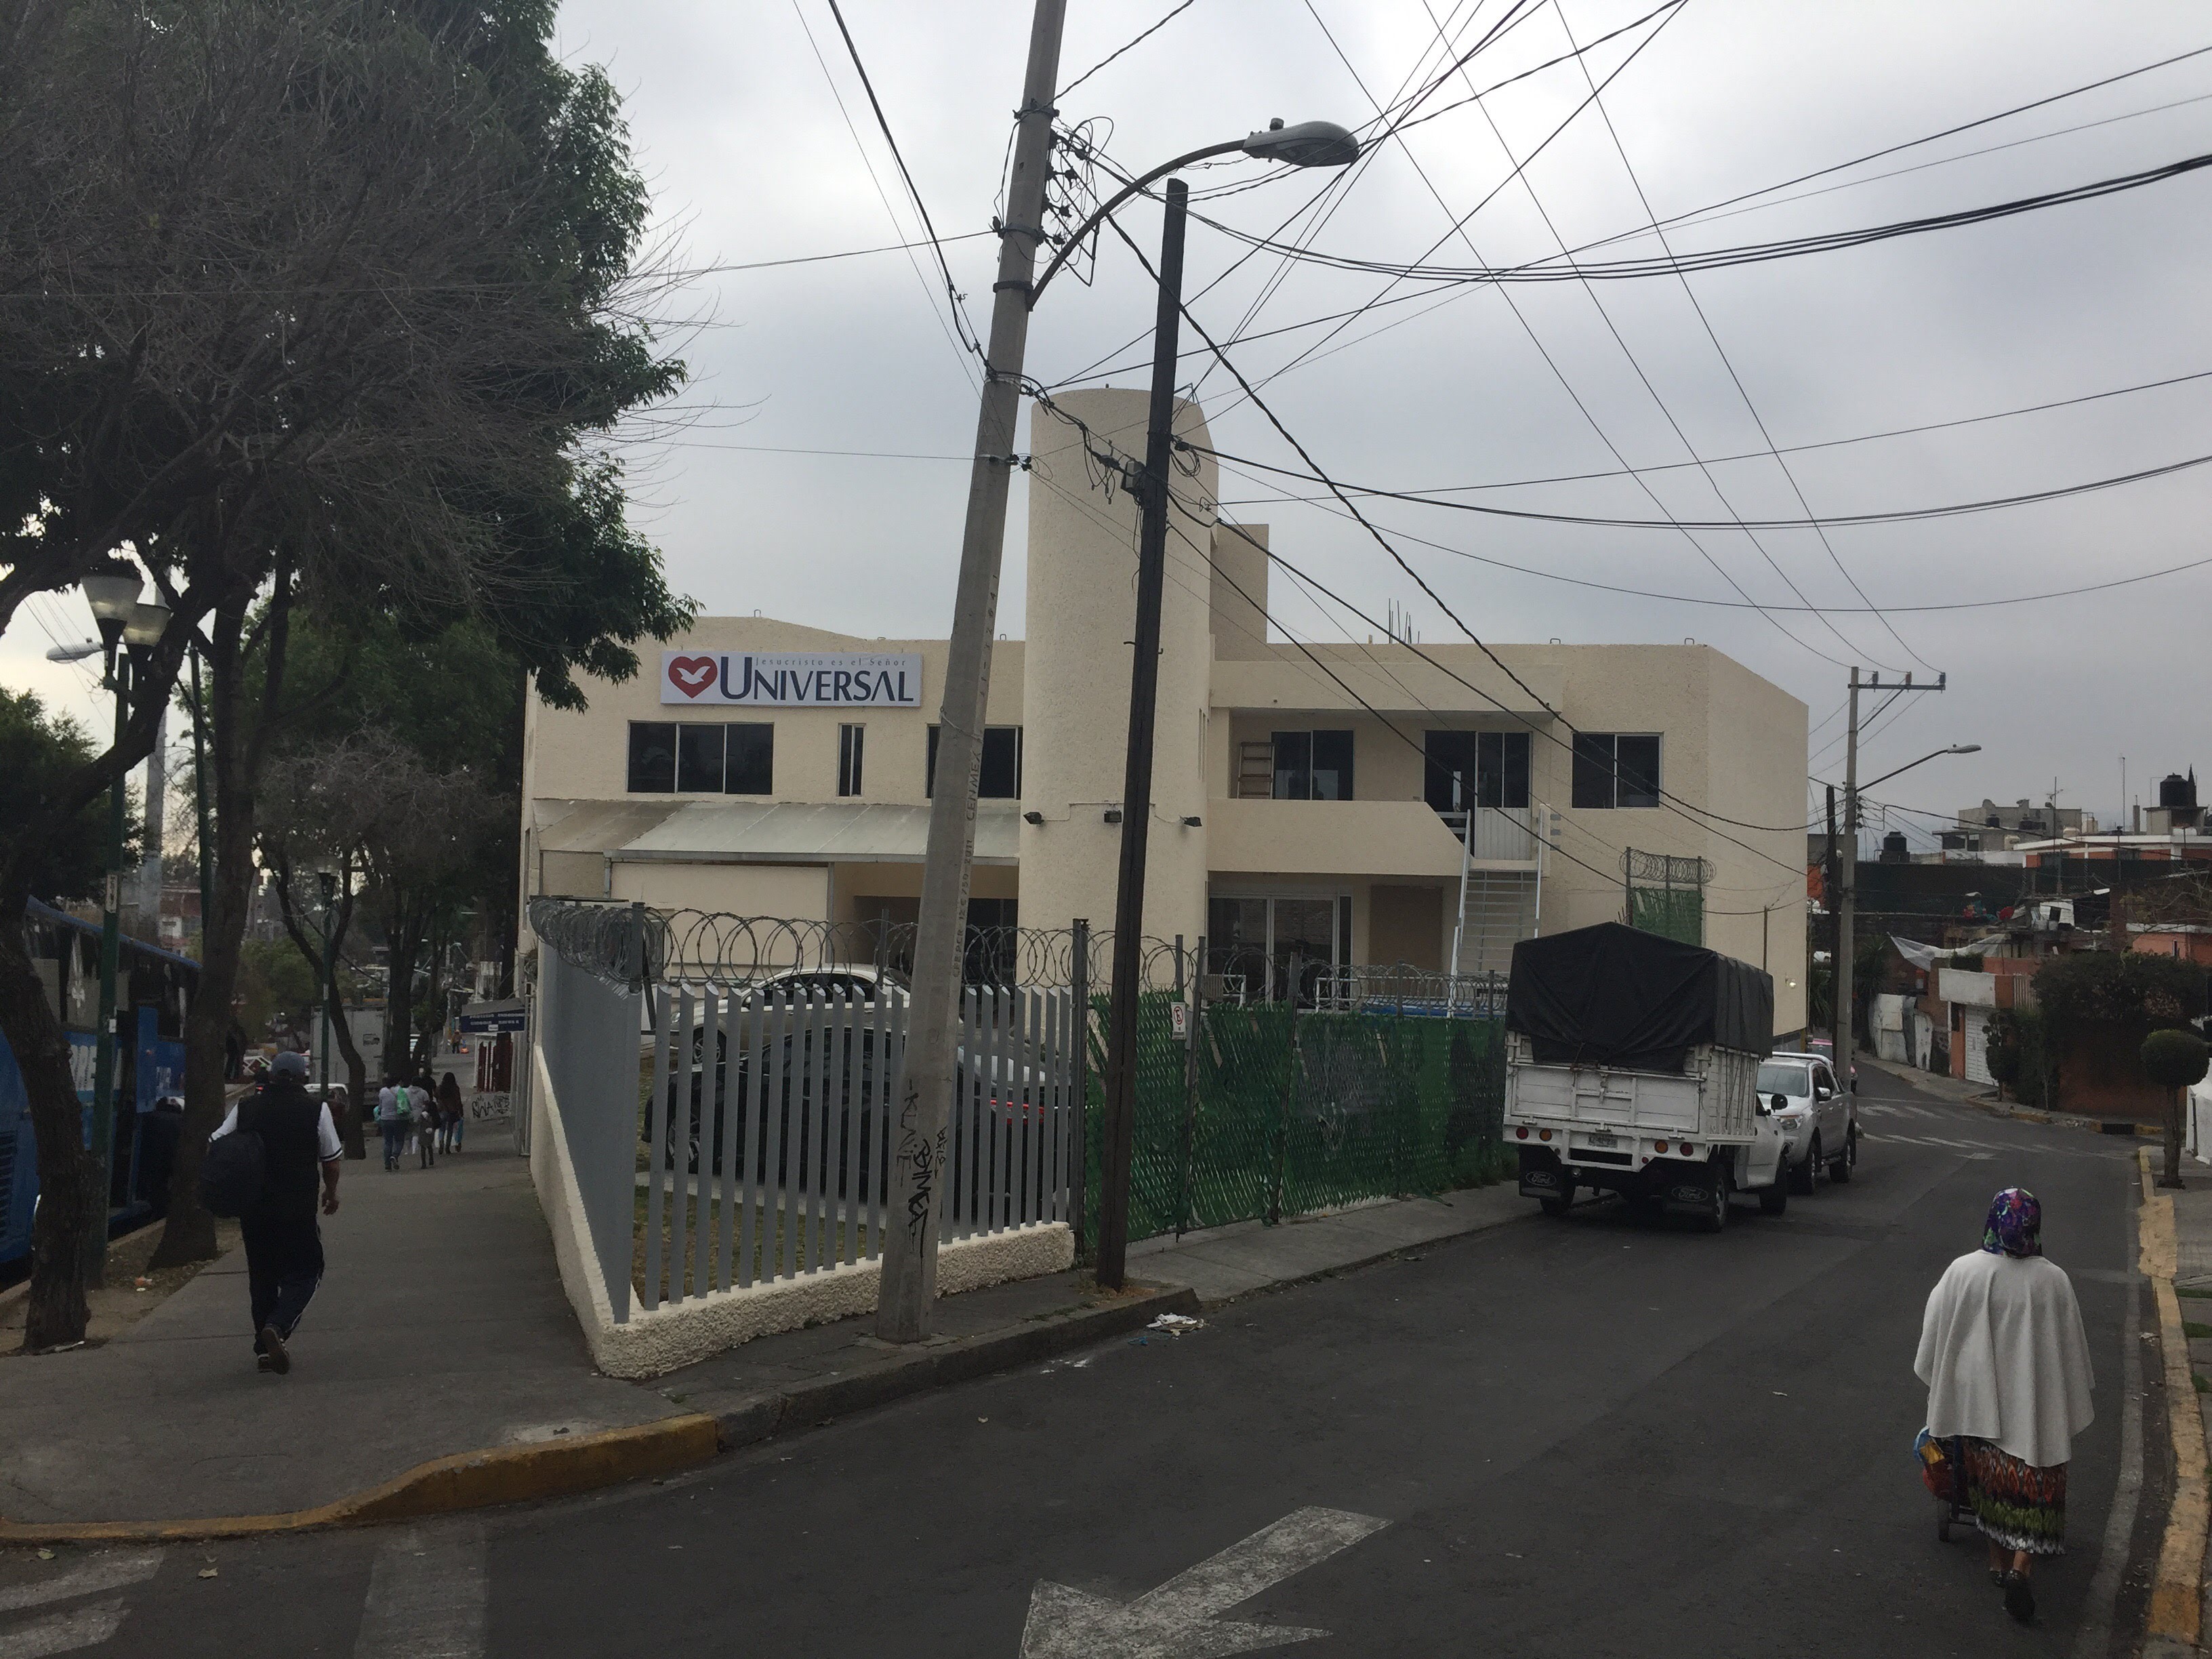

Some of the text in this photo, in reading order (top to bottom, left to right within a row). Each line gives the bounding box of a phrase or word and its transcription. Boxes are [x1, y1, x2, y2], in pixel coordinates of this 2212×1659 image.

[720, 656, 914, 702] UNIVERSAL
[756, 657, 823, 666] Jesucristo
[851, 658, 861, 666] el
[869, 658, 906, 666] Señor
[966, 749, 981, 821] CENMEX
